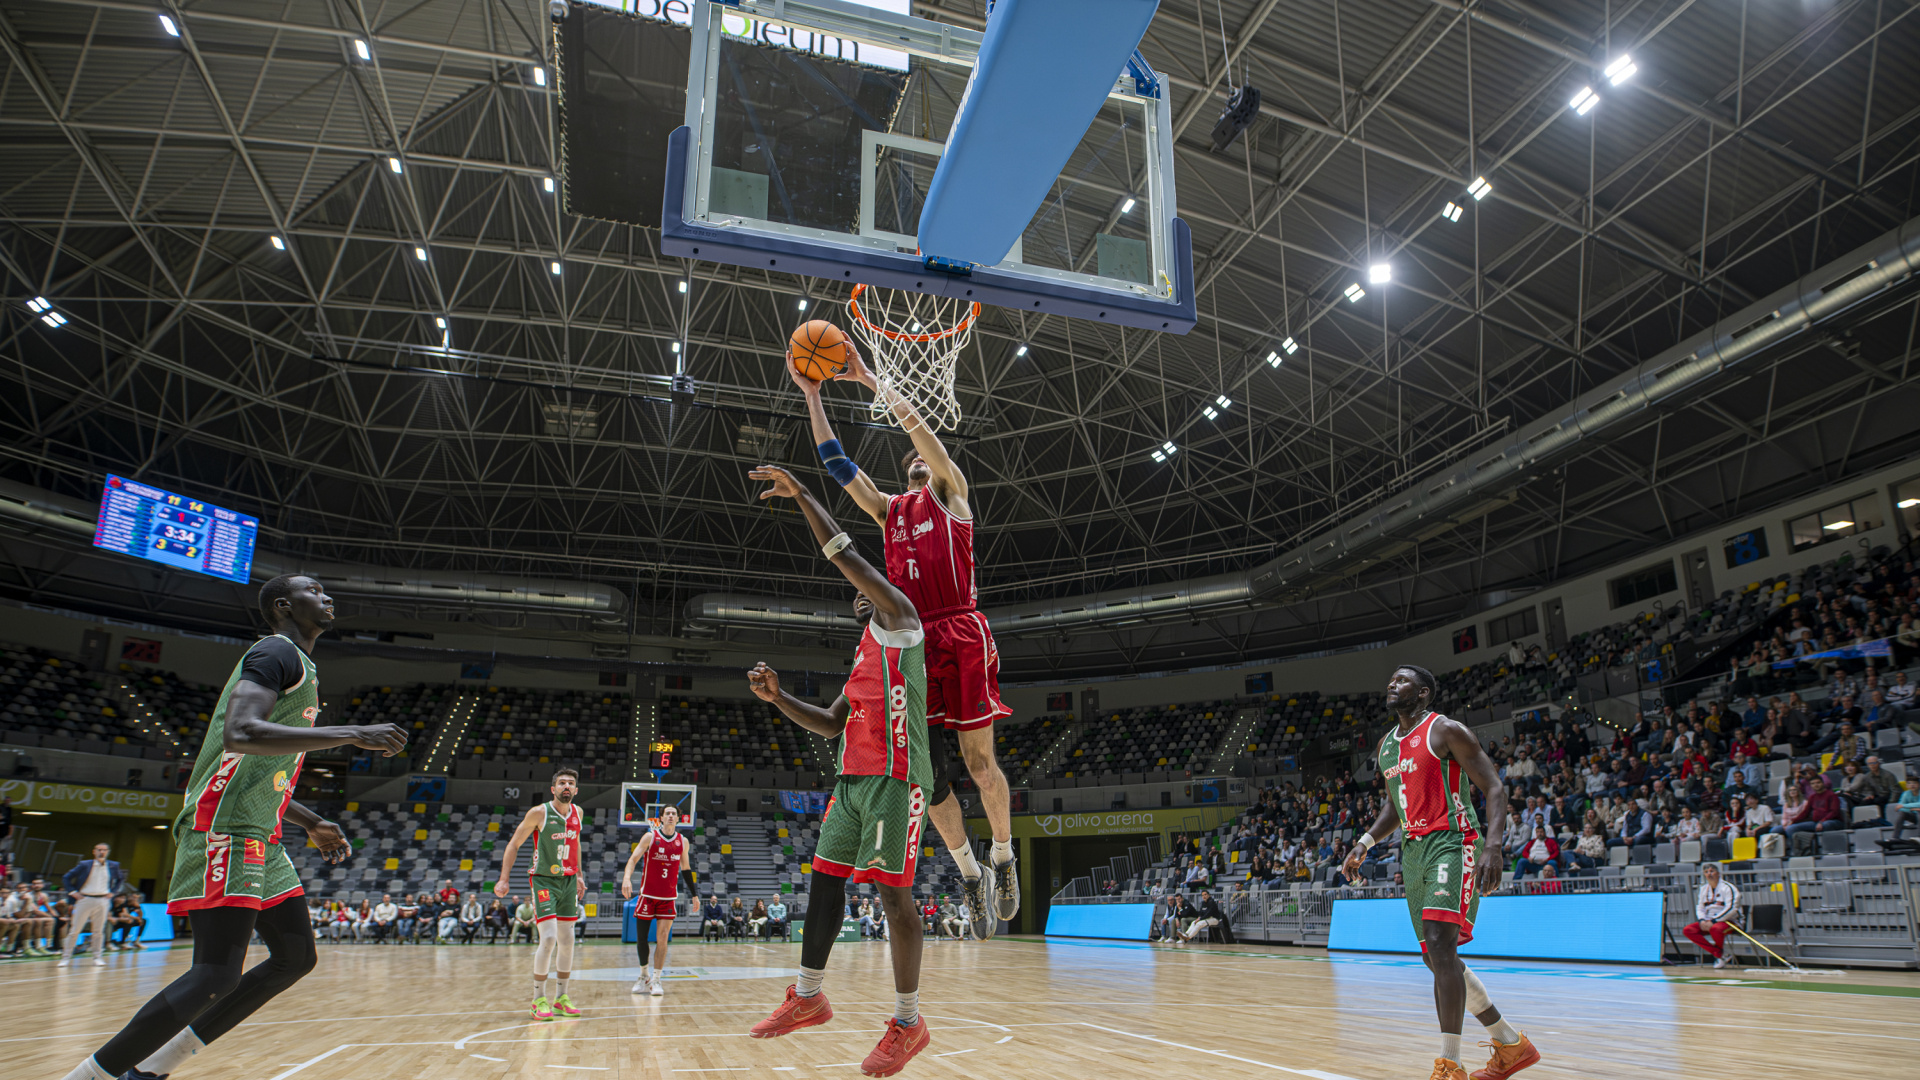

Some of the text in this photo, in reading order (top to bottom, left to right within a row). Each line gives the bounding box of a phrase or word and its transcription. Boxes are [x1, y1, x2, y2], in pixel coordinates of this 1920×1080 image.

[168, 495, 204, 512] 11 14
[178, 512, 185, 522] 1
[165, 525, 196, 544] 3:34
[156, 538, 167, 550] 3
[186, 546, 197, 558] 2
[1734, 532, 1759, 565] 8
[1647, 659, 1663, 683] 8
[1252, 673, 1267, 694] 5
[656, 743, 674, 752] 3:34
[1329, 738, 1349, 750] Salida
[661, 753, 670, 767] 6
[38, 784, 169, 808] olivo arena
[503, 787, 520, 799] 30
[1202, 778, 1220, 802] 5
[1398, 783, 1408, 810] 5
[1064, 813, 1153, 829] olivo arena
[874, 820, 884, 850] 1
[556, 844, 571, 860] 30
[661, 868, 669, 879] 3
[1437, 863, 1449, 884] 5
[642, 904, 648, 912] 3
